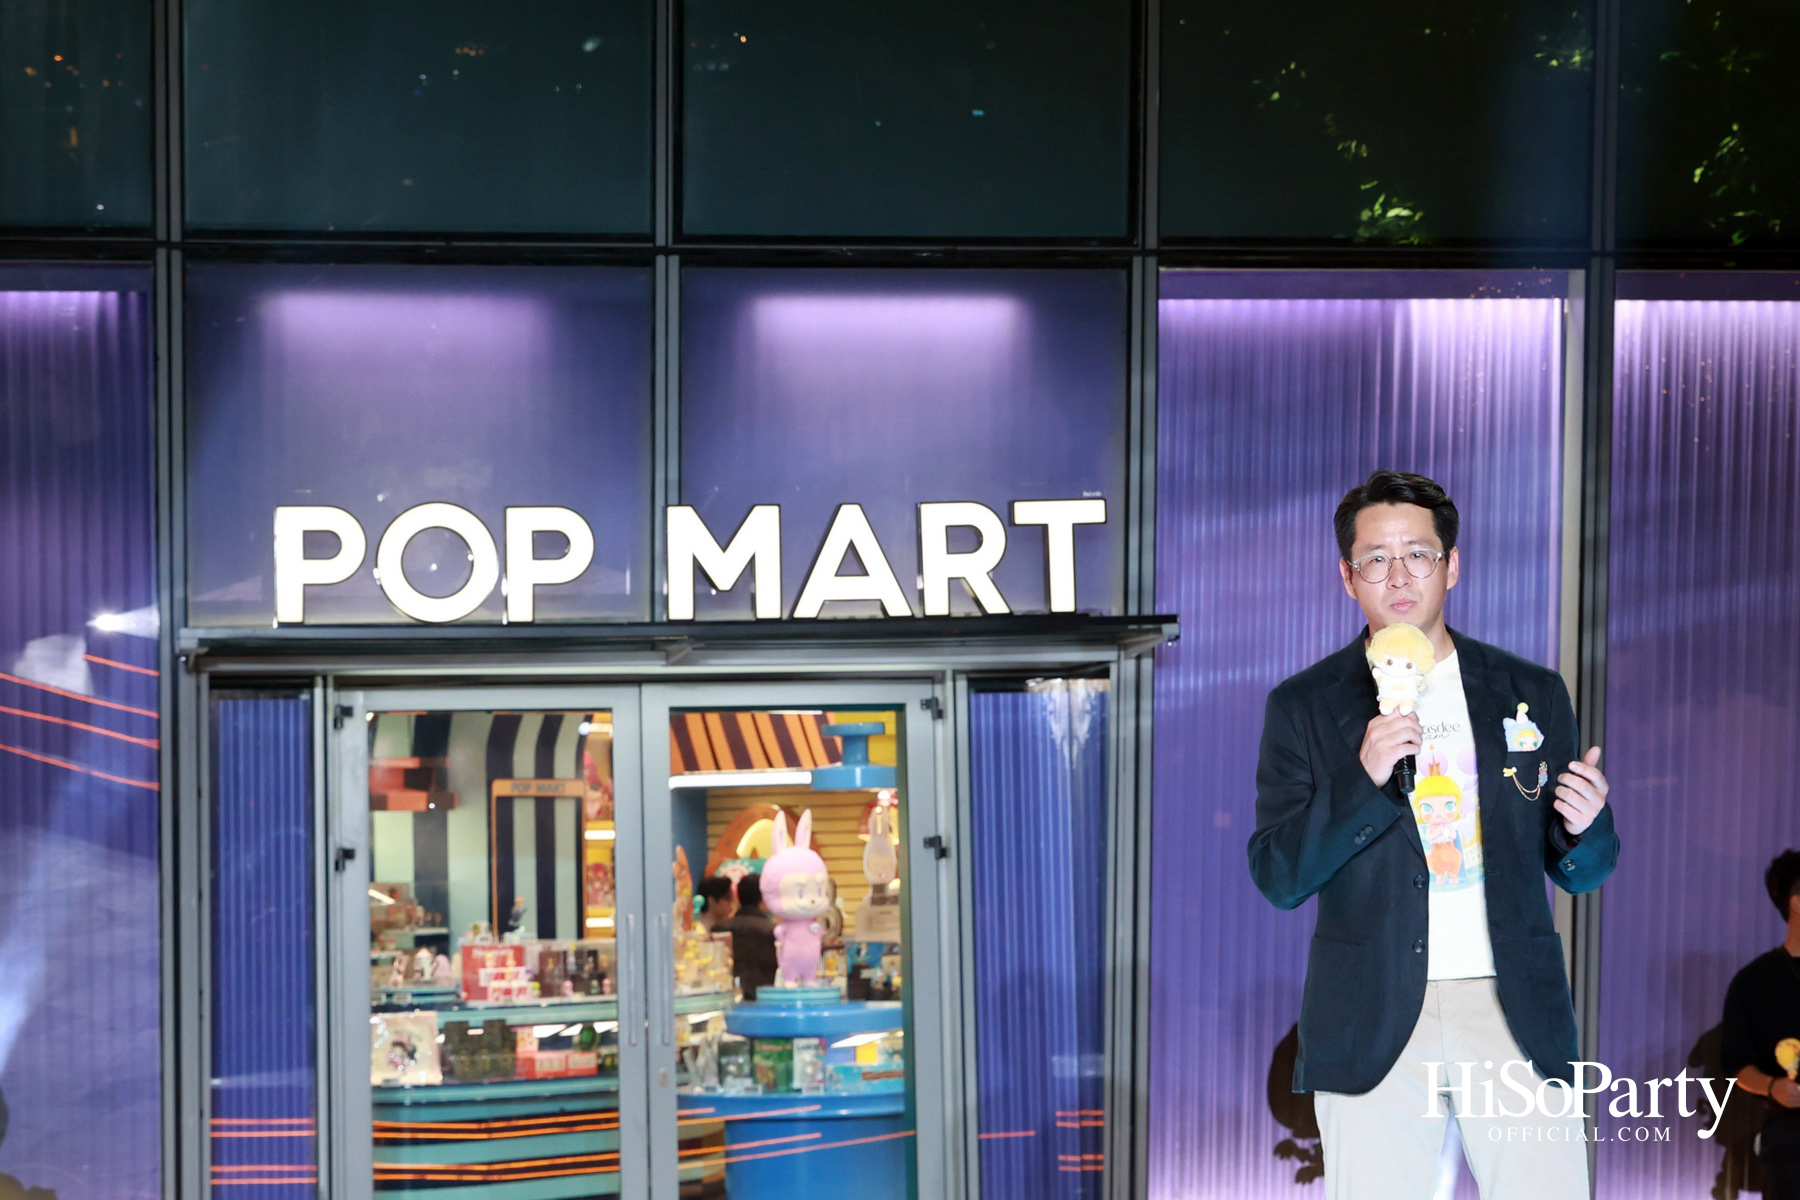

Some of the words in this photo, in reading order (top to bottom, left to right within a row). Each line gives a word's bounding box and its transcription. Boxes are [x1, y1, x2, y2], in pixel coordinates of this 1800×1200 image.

[274, 502, 595, 624] POP
[666, 499, 1107, 620] MART
[1422, 721, 1460, 734] asdee
[511, 781, 533, 793] POP
[536, 782, 566, 793] MART
